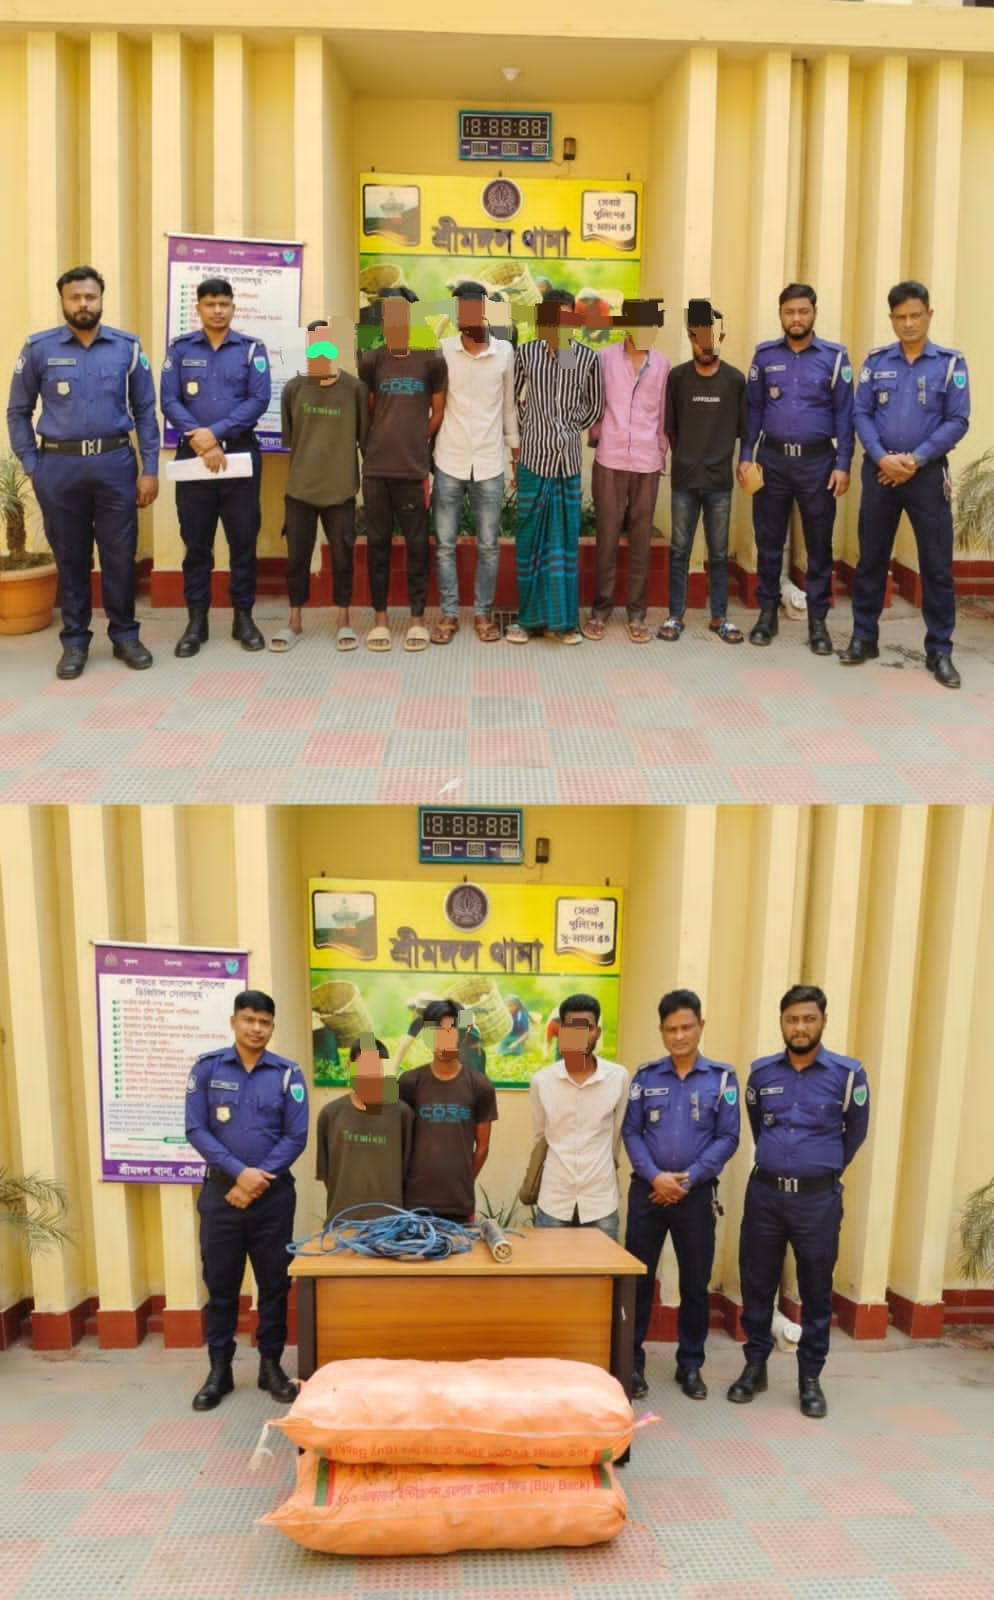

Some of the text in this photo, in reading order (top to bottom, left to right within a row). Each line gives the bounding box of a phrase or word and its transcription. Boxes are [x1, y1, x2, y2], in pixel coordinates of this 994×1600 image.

[431, 215, 572, 258] শ্রীমঙ্গল থানা
[389, 926, 545, 972] শ্রীমঙ্গল থানা
